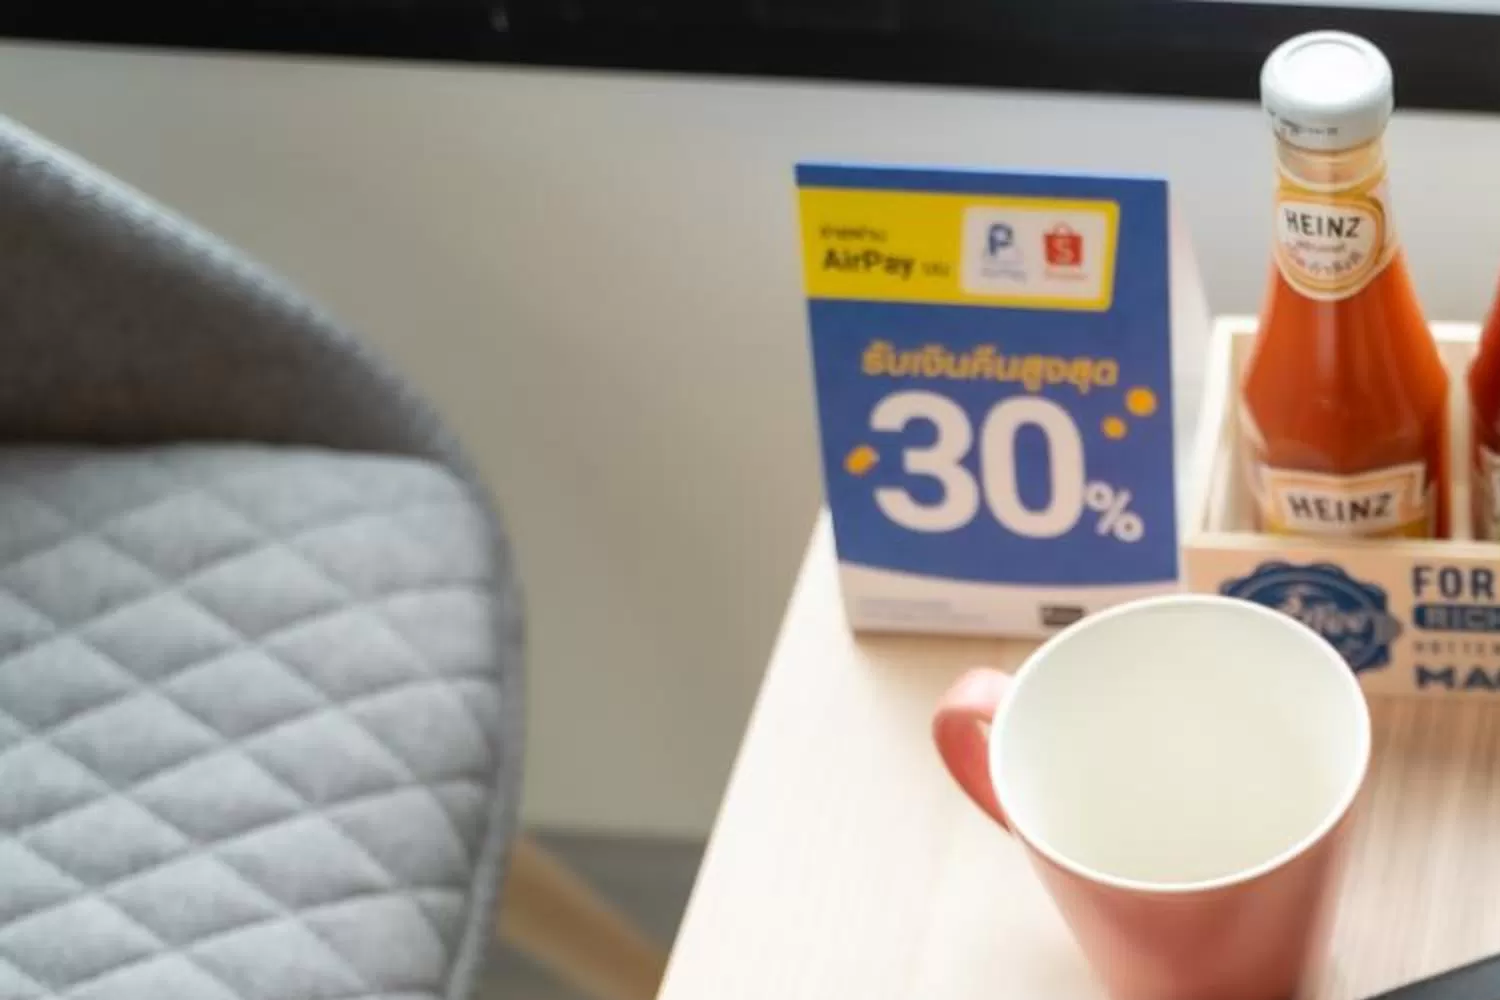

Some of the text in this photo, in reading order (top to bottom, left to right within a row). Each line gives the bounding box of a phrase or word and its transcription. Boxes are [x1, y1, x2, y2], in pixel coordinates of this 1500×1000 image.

[1283, 206, 1363, 239] HEINZ
[823, 249, 915, 281] AirPay
[868, 388, 1145, 542] 30%
[1287, 491, 1394, 522] HEINZ
[1411, 565, 1495, 600] FOR
